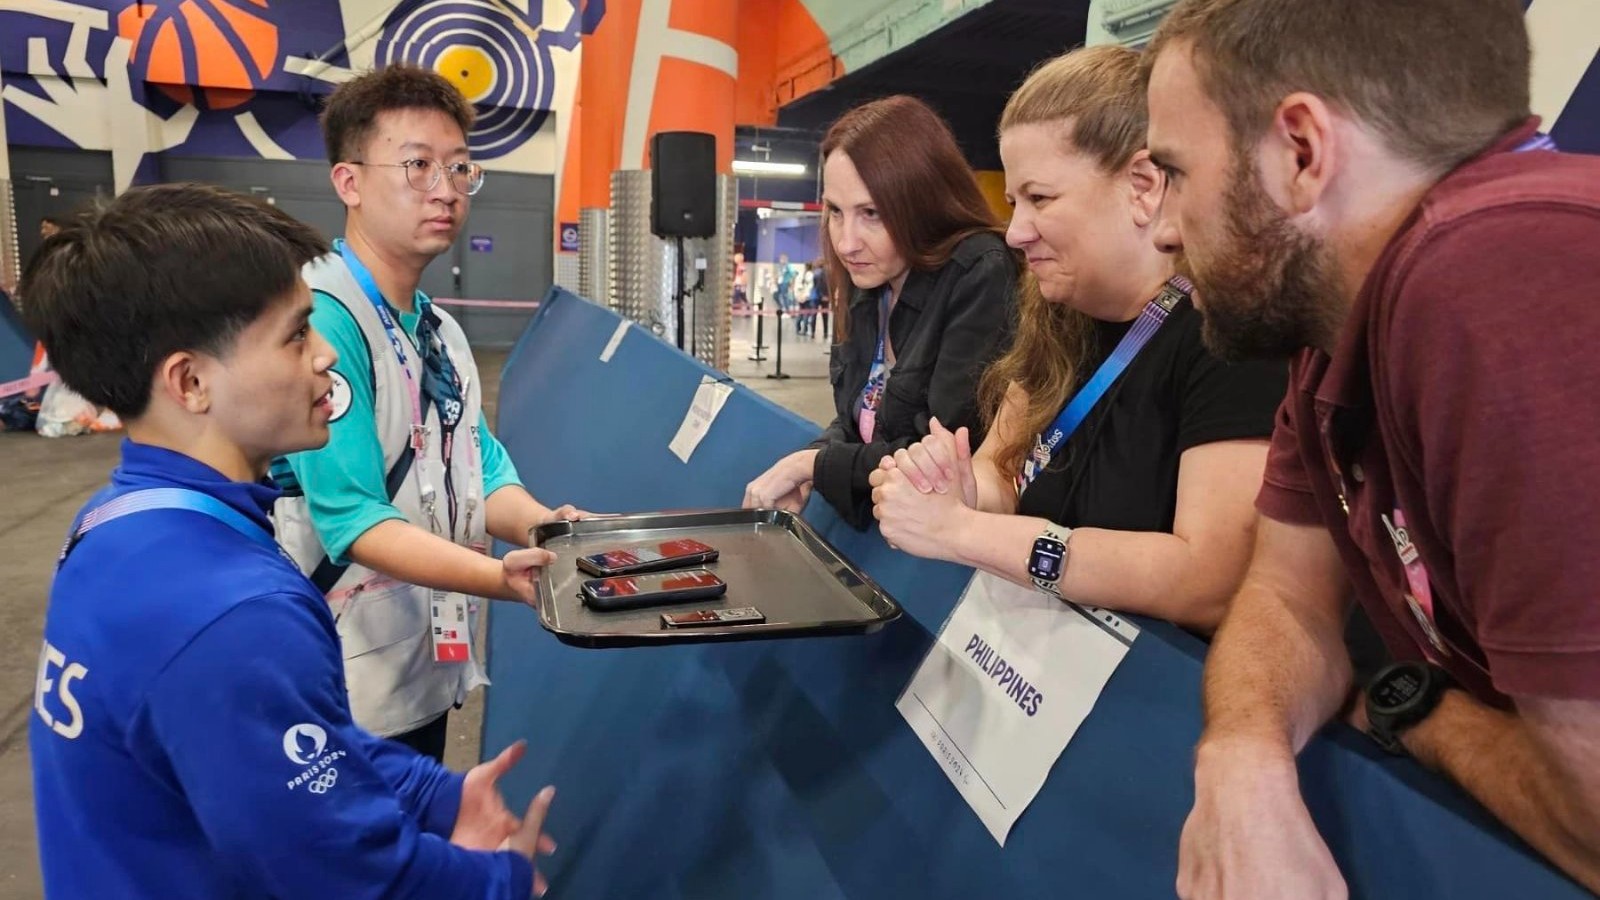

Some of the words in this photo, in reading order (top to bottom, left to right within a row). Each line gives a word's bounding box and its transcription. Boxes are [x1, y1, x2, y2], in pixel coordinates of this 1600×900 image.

[964, 633, 1043, 717] PHILIPPINES
[286, 765, 320, 790] PARIS
[318, 750, 347, 769] 2024
